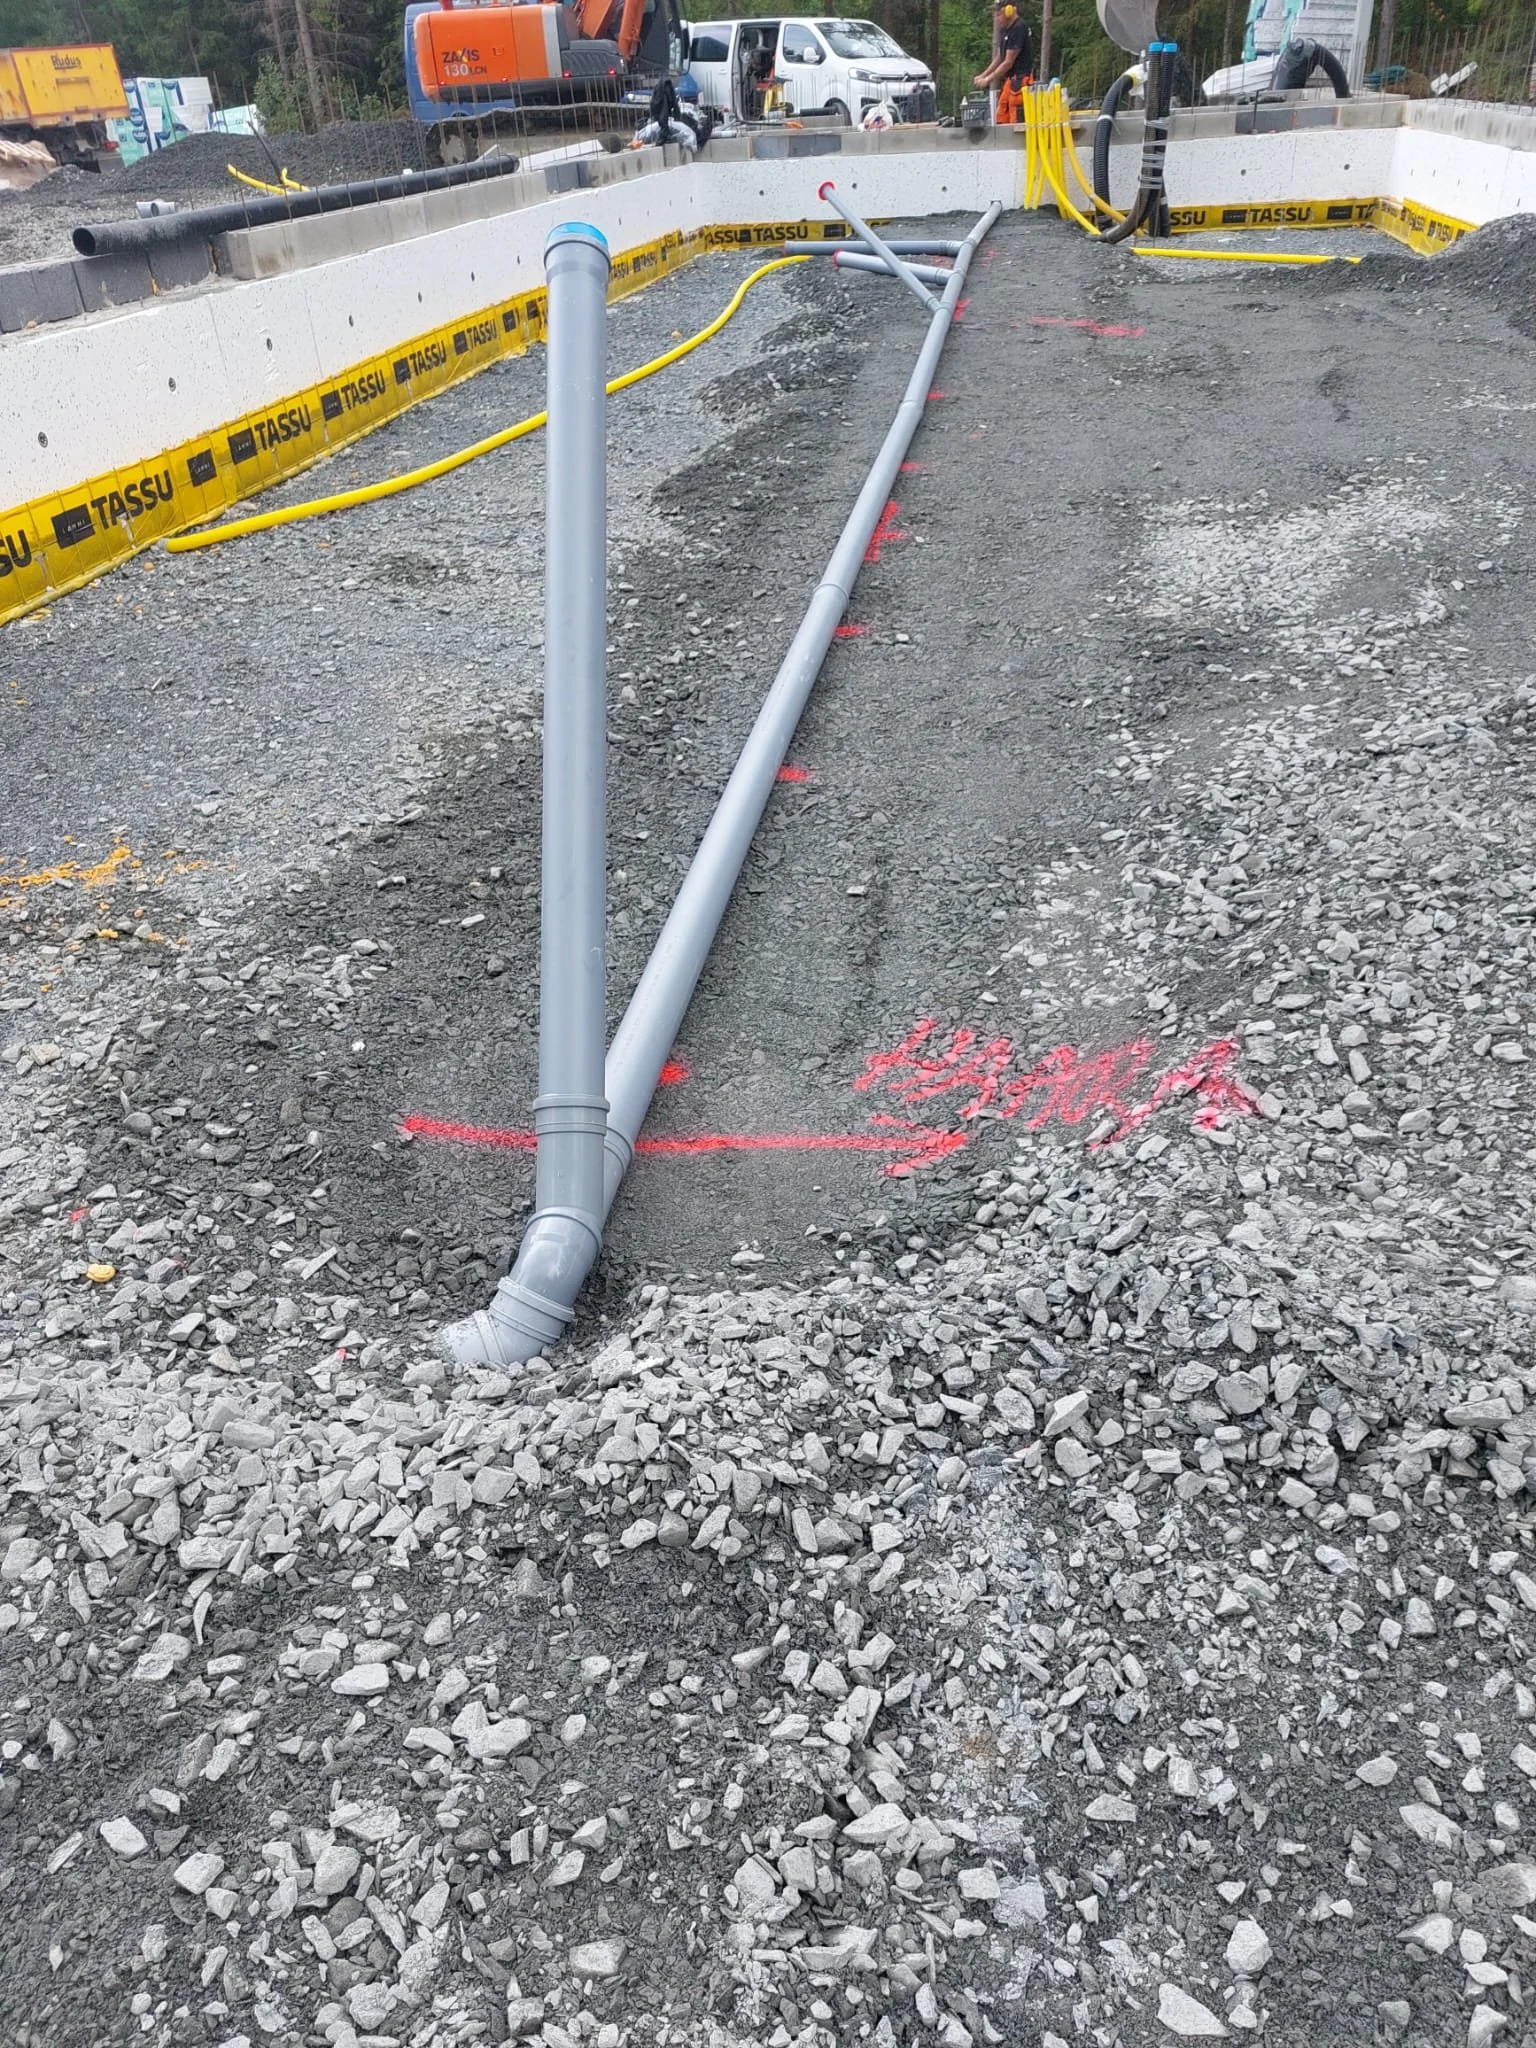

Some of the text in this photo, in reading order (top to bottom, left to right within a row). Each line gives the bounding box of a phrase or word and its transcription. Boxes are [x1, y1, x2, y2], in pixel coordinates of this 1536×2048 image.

[442, 48, 480, 63] ZAXIS
[1248, 206, 1312, 224] TASSU
[754, 225, 808, 242] TASSU
[466, 318, 498, 351] TASSU
[409, 339, 447, 377] TASSU
[341, 368, 387, 411] TASSU
[254, 403, 312, 451] TASSU
[91, 469, 174, 531] TASSU
